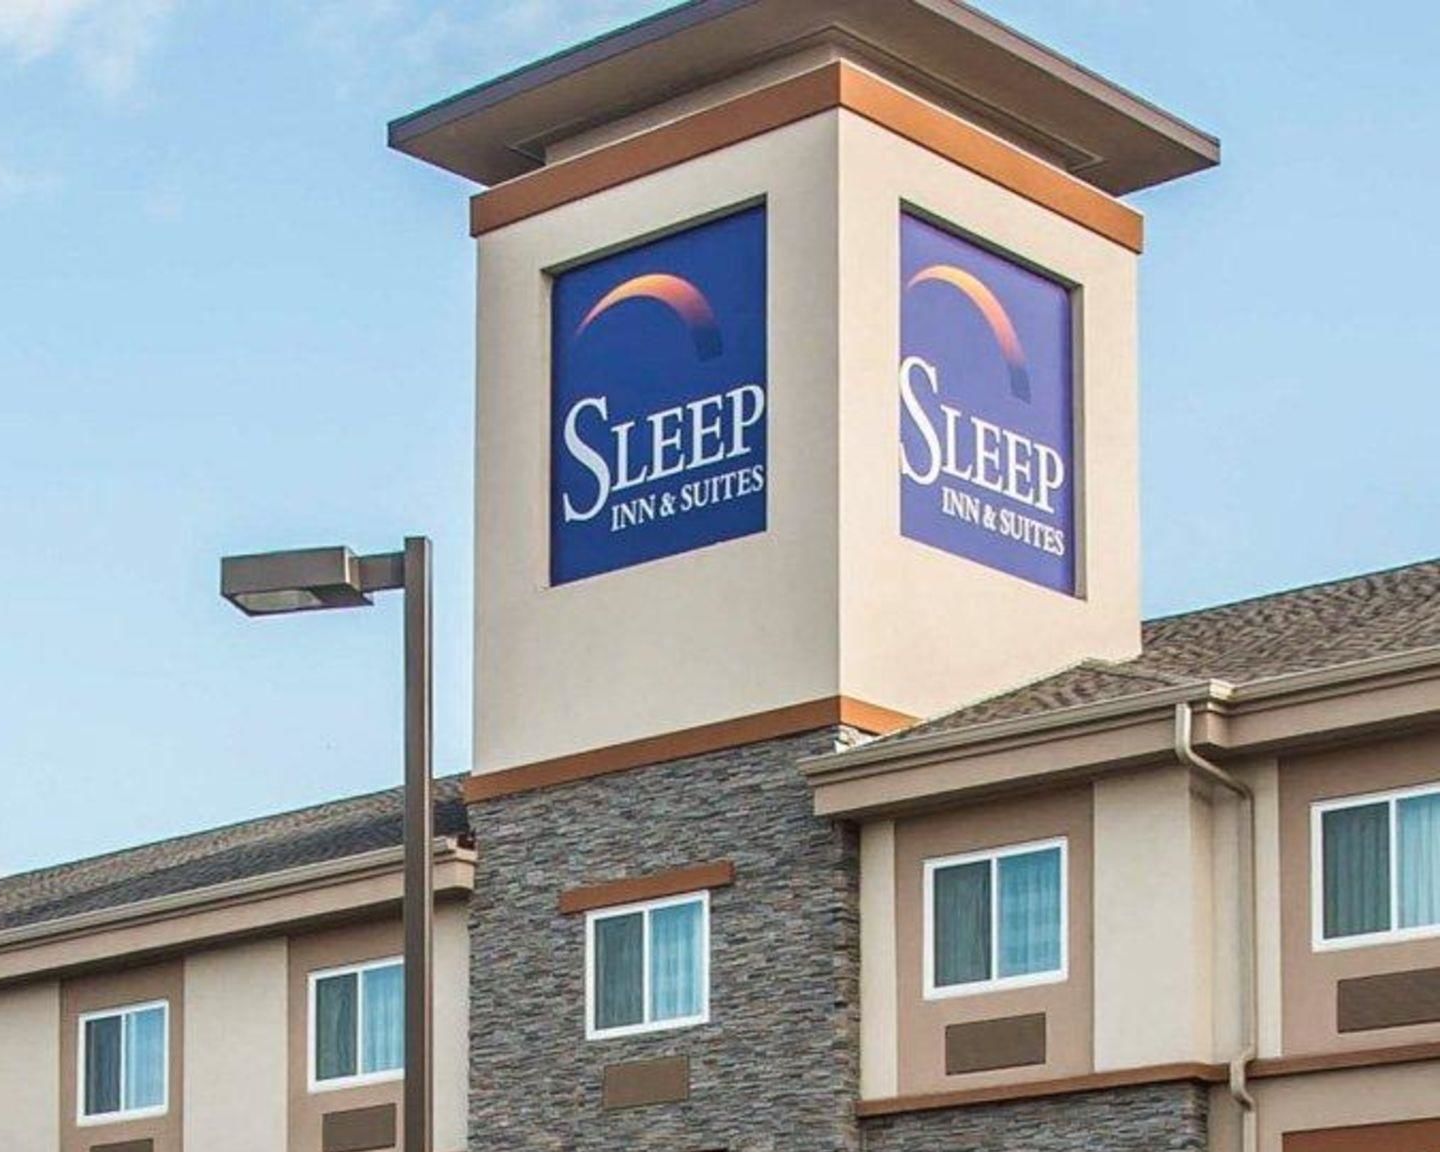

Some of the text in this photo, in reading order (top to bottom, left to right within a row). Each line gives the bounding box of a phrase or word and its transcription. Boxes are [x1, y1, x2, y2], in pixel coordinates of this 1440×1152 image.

[563, 384, 765, 523] SLEEP
[898, 355, 1064, 513] SLEEP
[611, 464, 765, 532] INN & SUITES
[942, 486, 1065, 556] INN & SUITES
